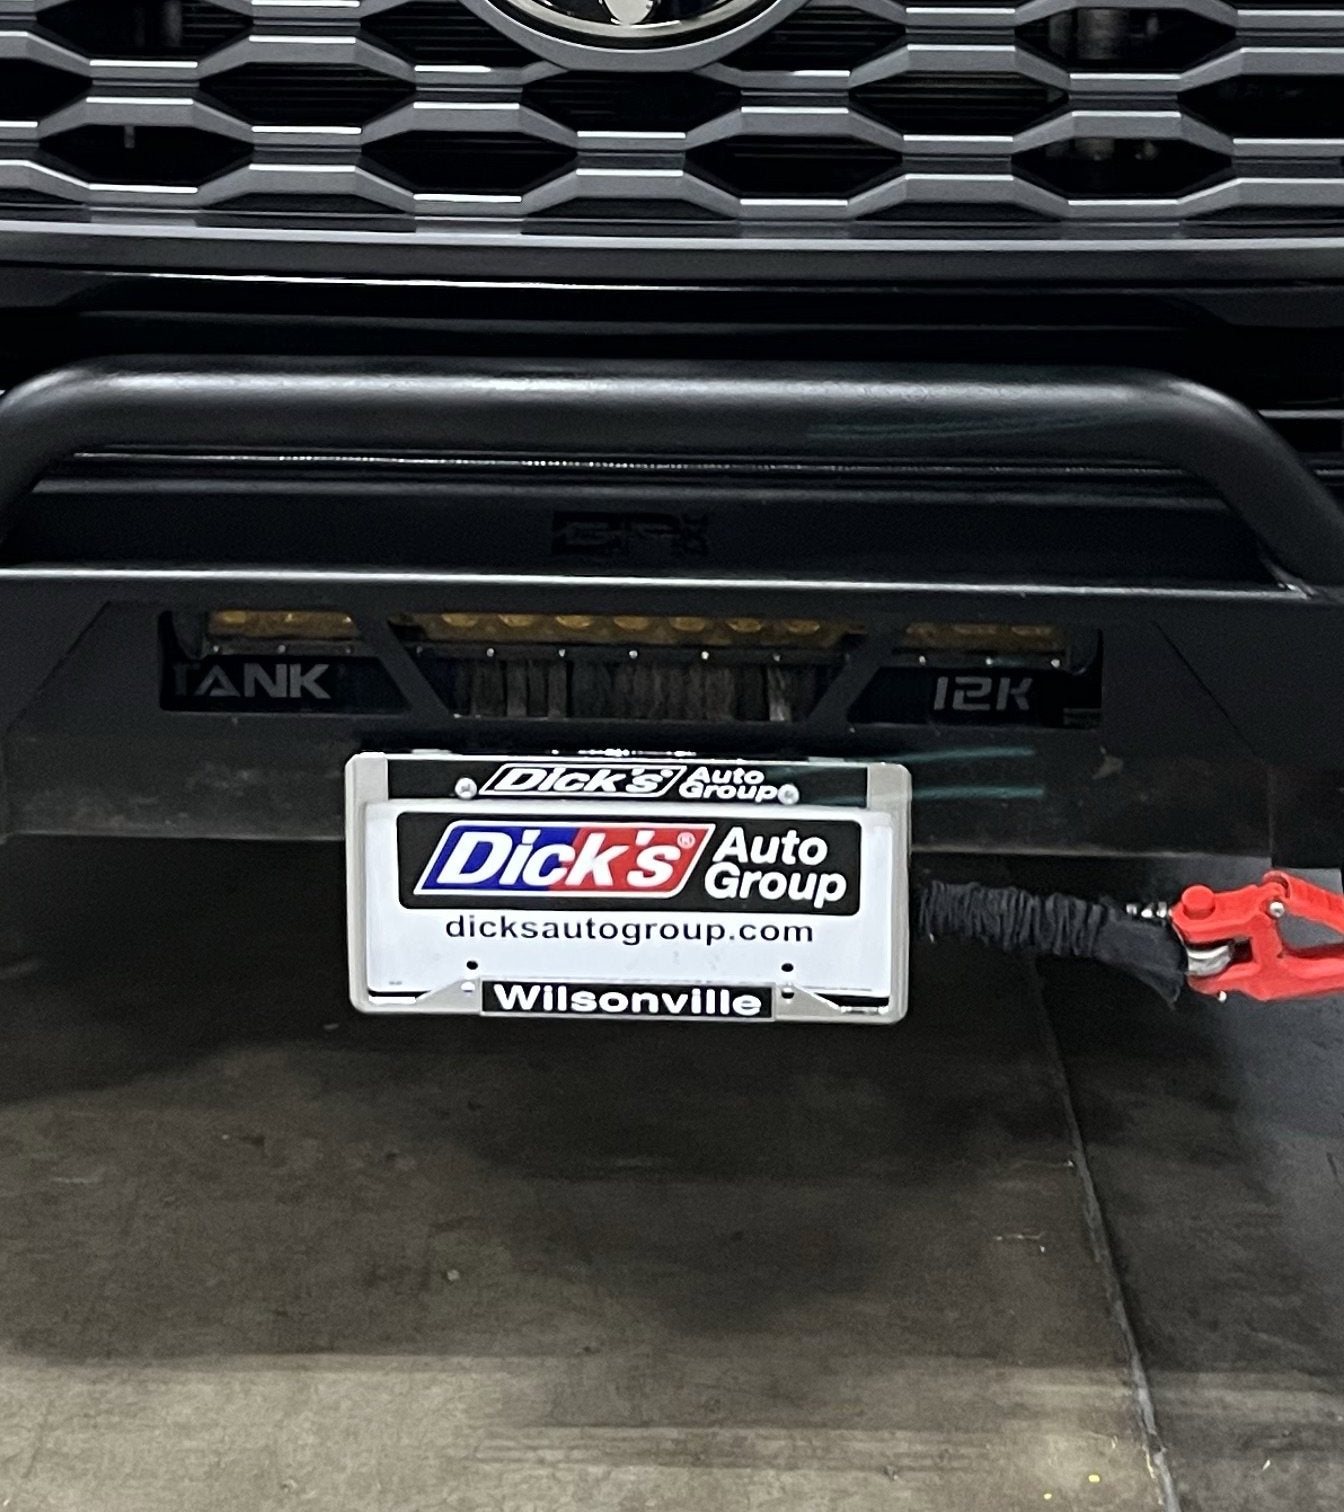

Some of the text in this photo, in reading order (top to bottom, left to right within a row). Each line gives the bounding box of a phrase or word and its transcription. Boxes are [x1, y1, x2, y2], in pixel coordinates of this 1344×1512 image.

[934, 676, 1034, 711] 12K
[493, 766, 665, 794] Dick's
[685, 765, 766, 785] Auto
[678, 783, 779, 803] Group
[436, 829, 682, 888] Dick's
[712, 826, 829, 866] Auto
[704, 861, 847, 909] Group
[445, 914, 815, 946] dicksautogroup.com
[493, 982, 763, 1017] Wilsonville
